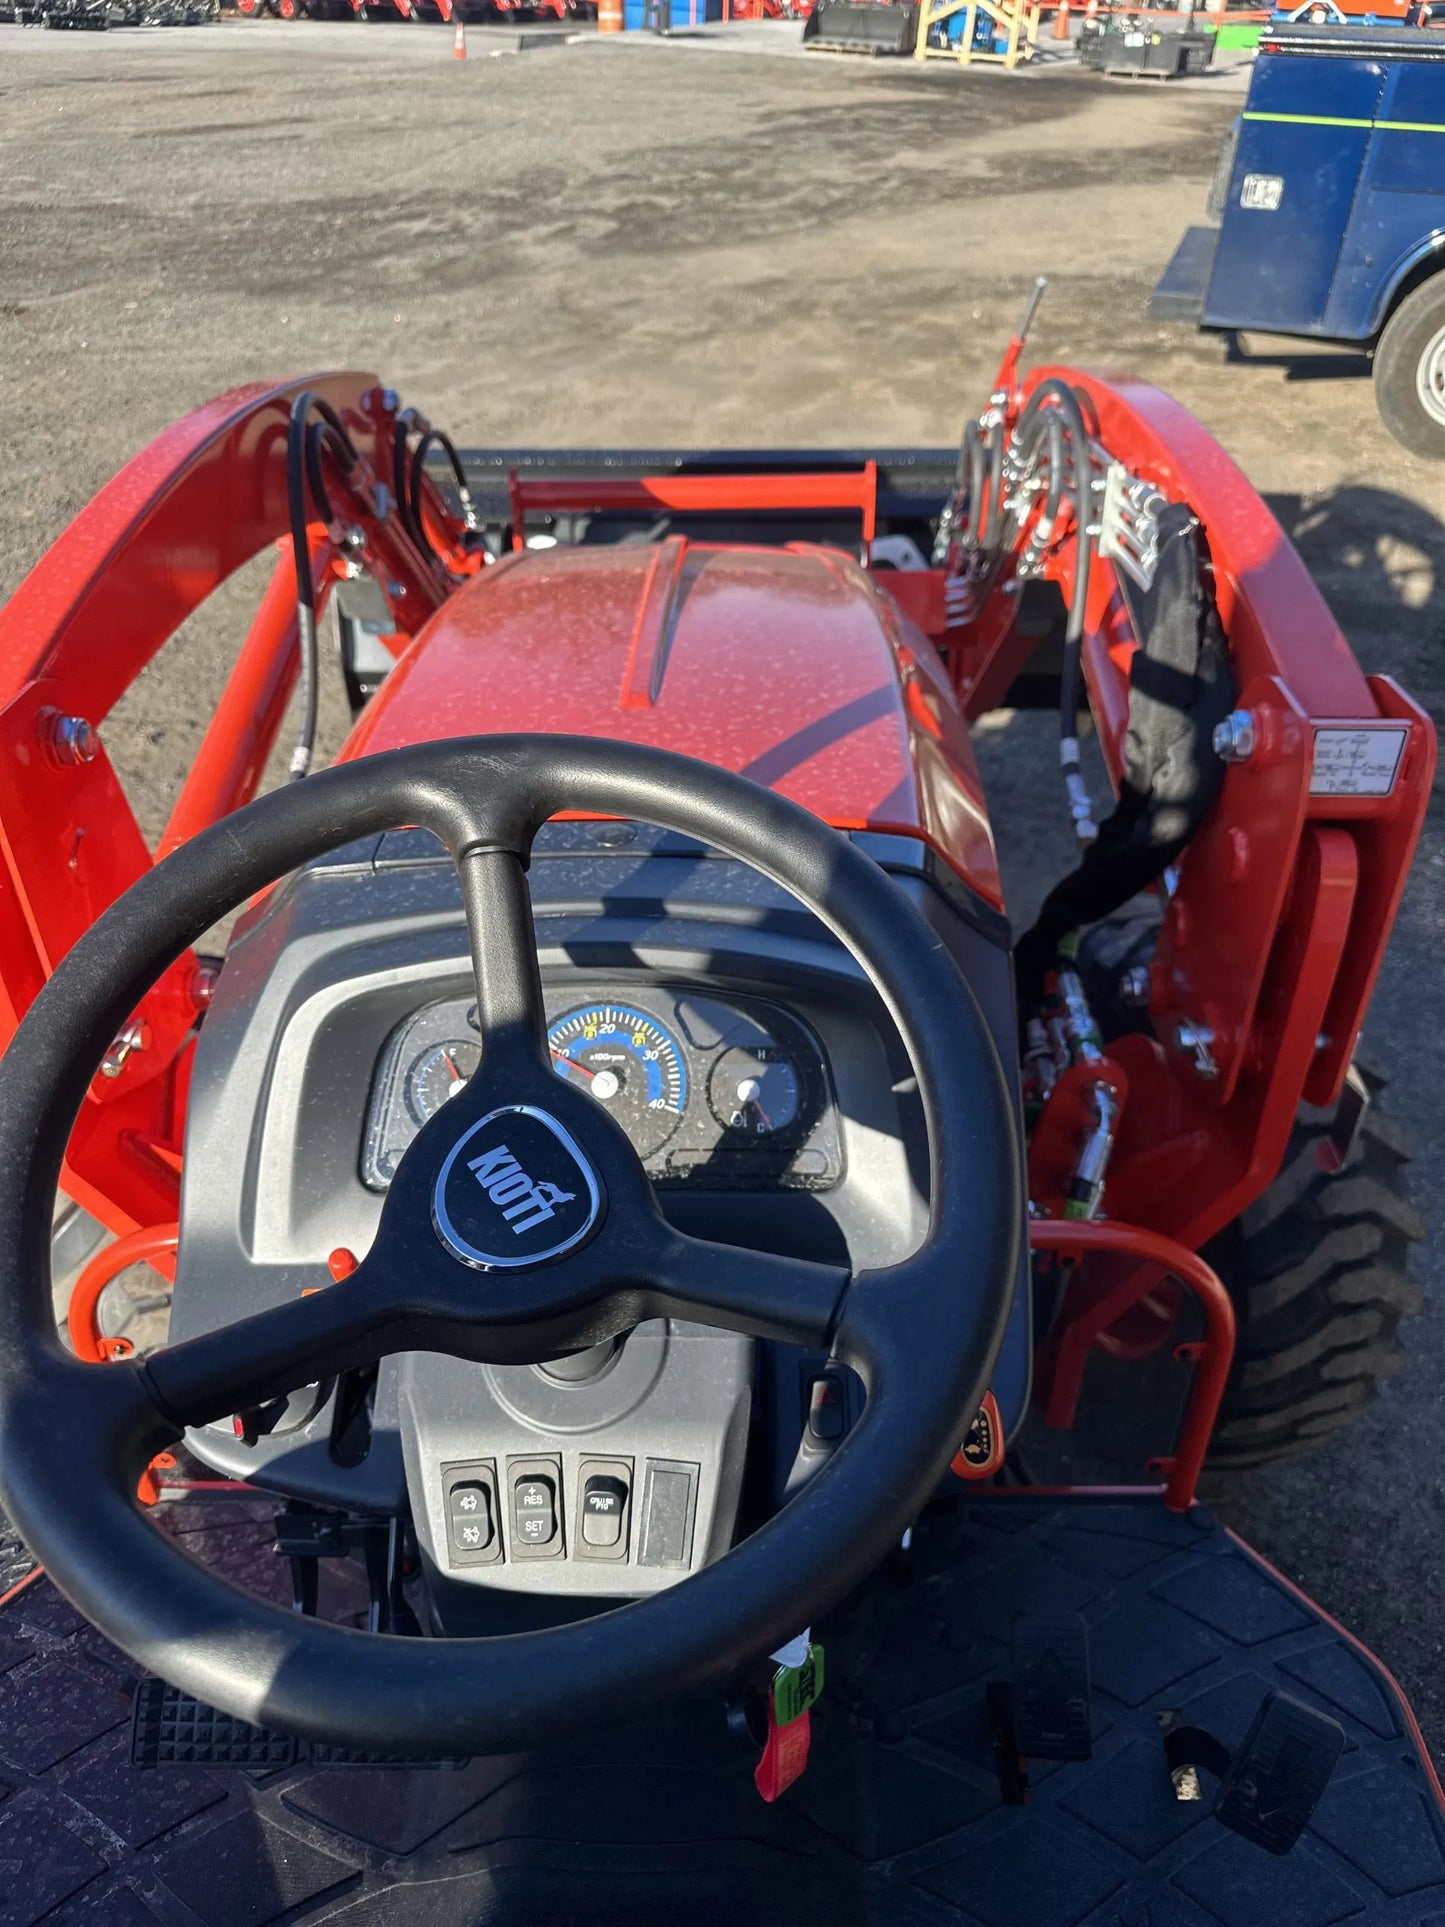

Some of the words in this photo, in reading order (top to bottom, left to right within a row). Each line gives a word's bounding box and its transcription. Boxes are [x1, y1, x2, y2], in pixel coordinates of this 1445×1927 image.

[599, 1023, 616, 1034] 20
[642, 1050, 659, 1060] 30
[757, 1049, 766, 1060] H
[648, 1098, 666, 1109] 40
[756, 1122, 765, 1133] C
[467, 1144, 556, 1235] KIOTI
[523, 1494, 544, 1506] RES
[525, 1520, 544, 1532] SET
